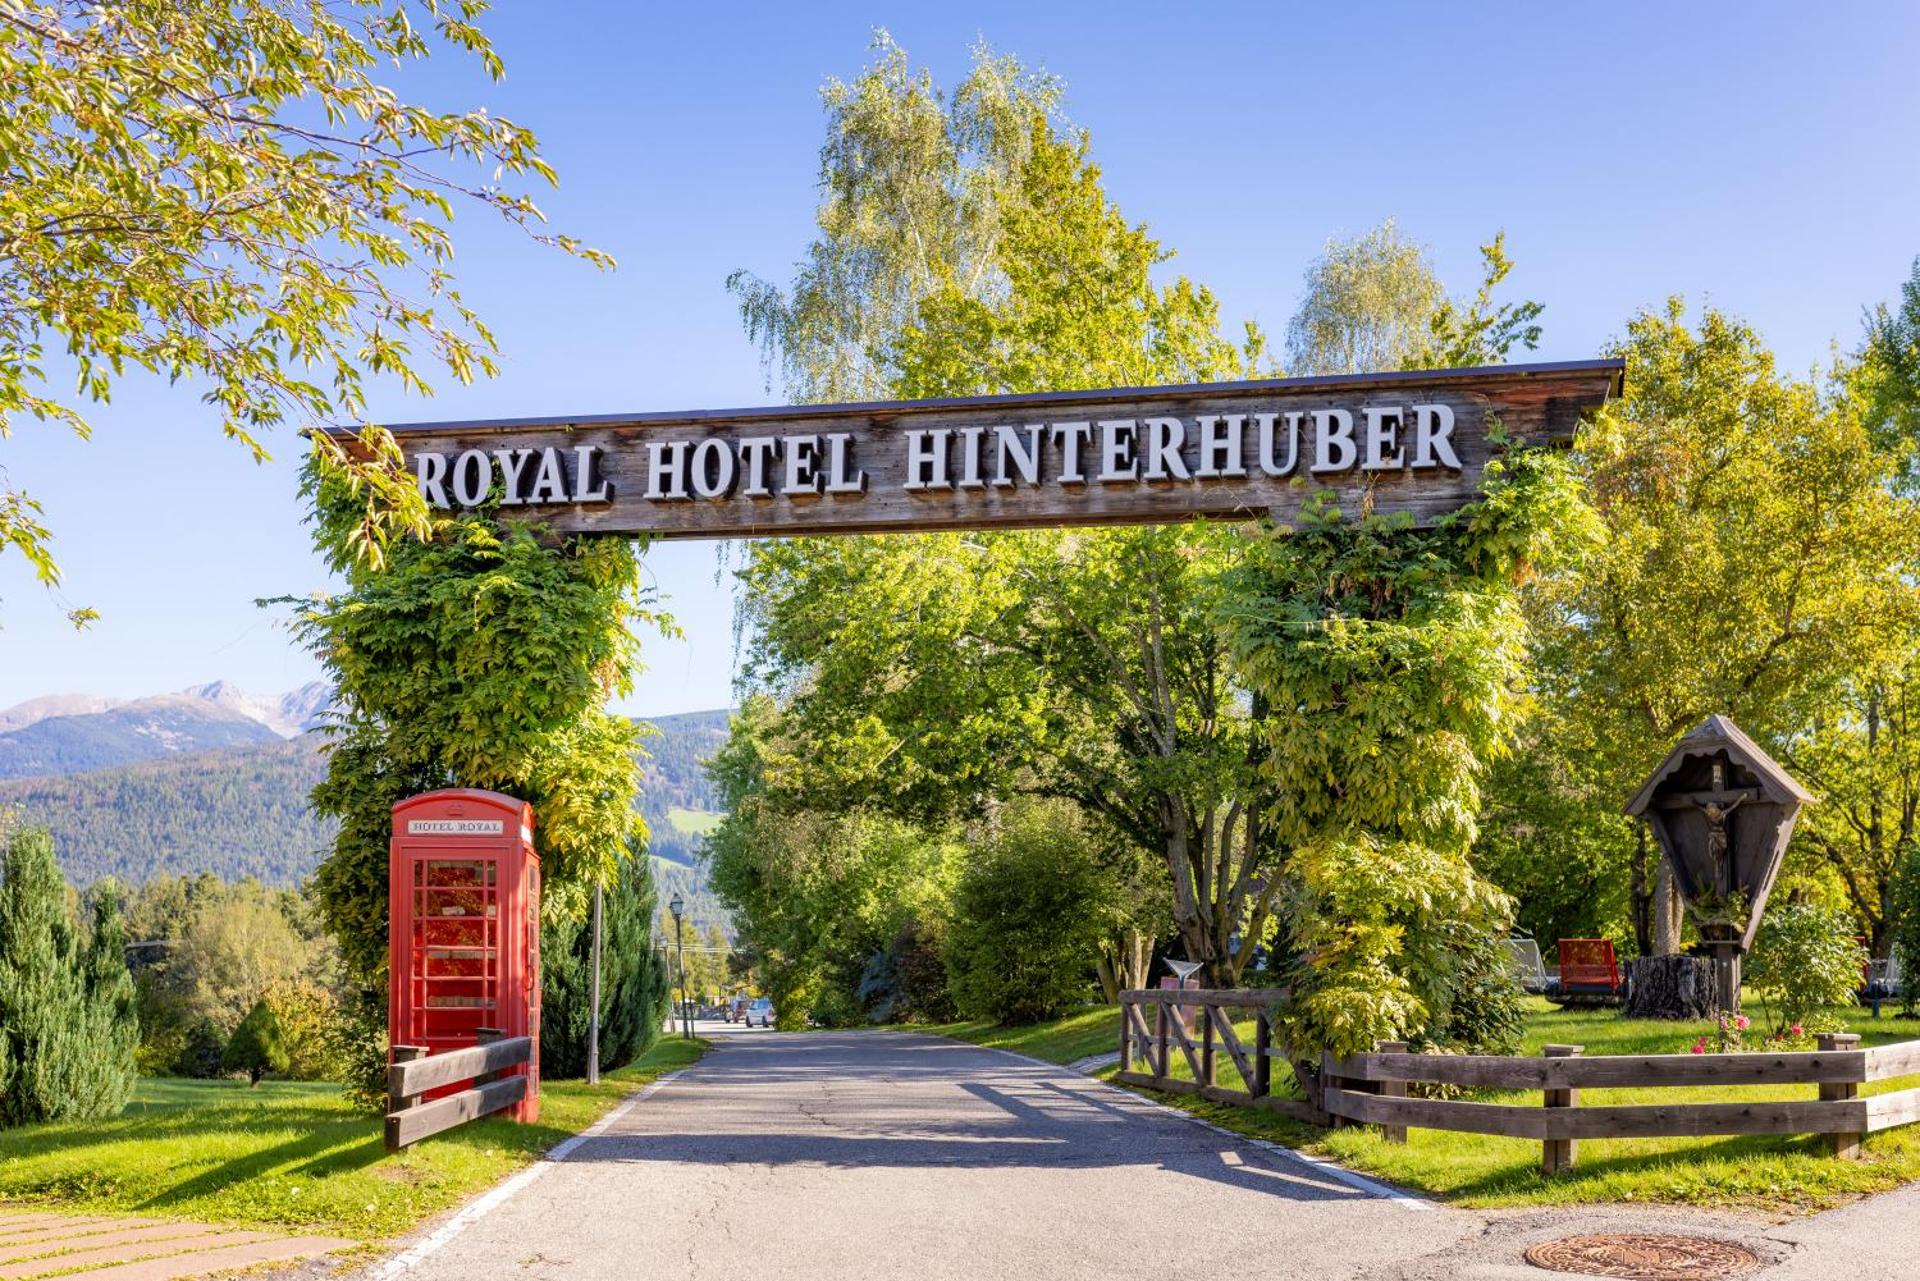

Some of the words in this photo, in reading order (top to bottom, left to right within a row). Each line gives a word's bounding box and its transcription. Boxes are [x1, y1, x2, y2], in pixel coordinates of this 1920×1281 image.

[415, 446, 613, 510] ROYAL
[643, 433, 869, 501] HOTEL
[903, 403, 1462, 491] HINTERHUBER
[413, 822, 454, 832] HOTEL
[457, 822, 500, 832] ROYAL
